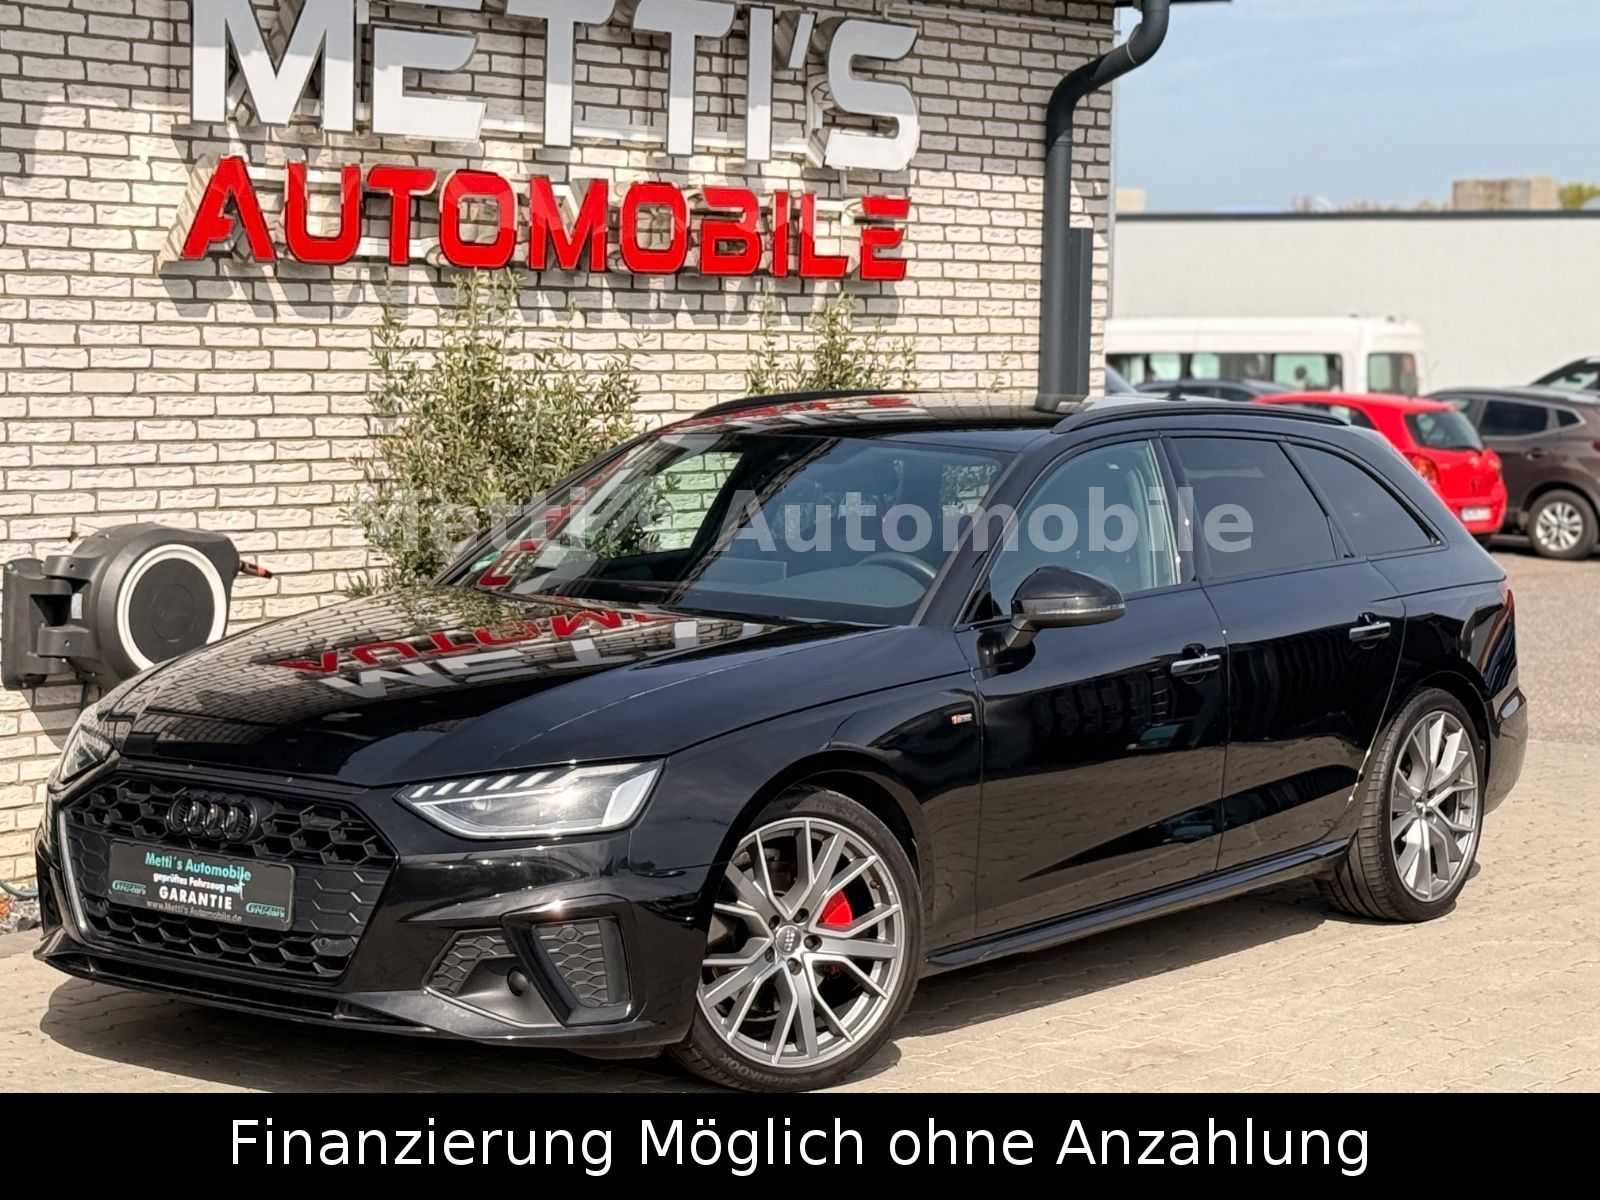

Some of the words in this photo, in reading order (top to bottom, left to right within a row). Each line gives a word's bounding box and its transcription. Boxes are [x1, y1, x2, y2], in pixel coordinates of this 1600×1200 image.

[182, 155, 911, 281] AUTOMOBILE
[185, 858, 252, 882] Automobile
[159, 885, 233, 911] GARANTIE
